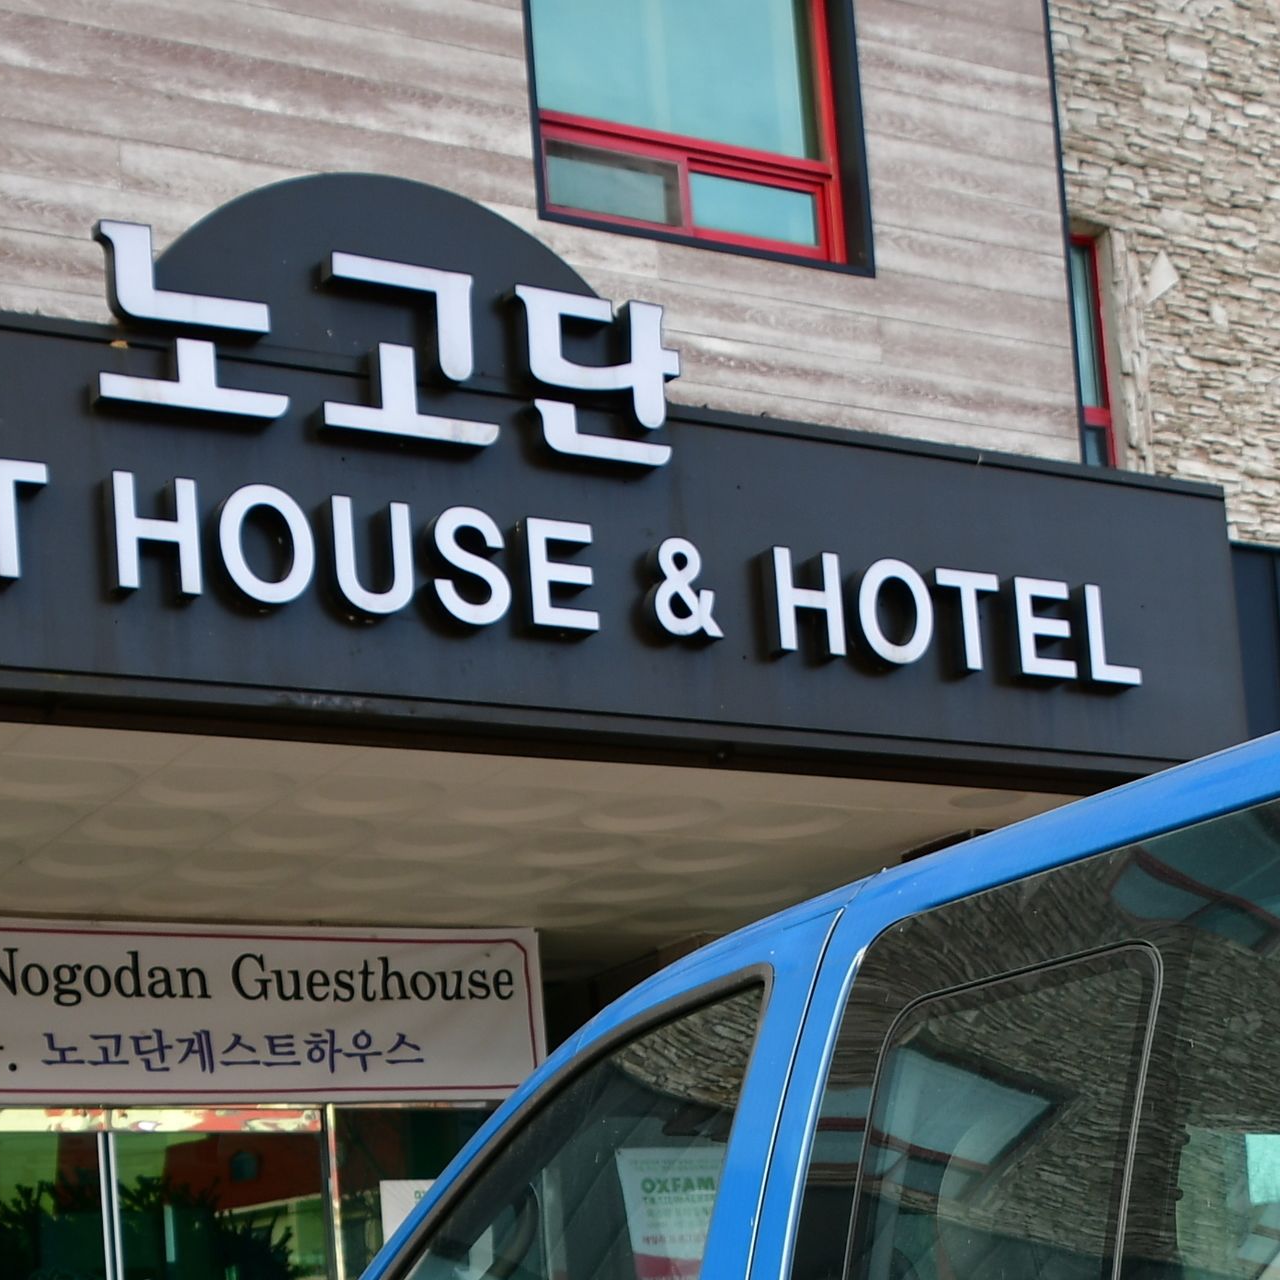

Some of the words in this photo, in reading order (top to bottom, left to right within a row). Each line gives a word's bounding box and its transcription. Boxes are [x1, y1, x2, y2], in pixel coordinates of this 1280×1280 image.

[95, 218, 682, 466] 노고단
[109, 469, 600, 633] HOUSE
[655, 536, 722, 638] &
[772, 545, 1143, 689] HOTEL
[231, 951, 515, 1004] Guesthouse
[40, 1025, 426, 1076] 노고단게스트하우스
[641, 1176, 716, 1194] OXFAM
